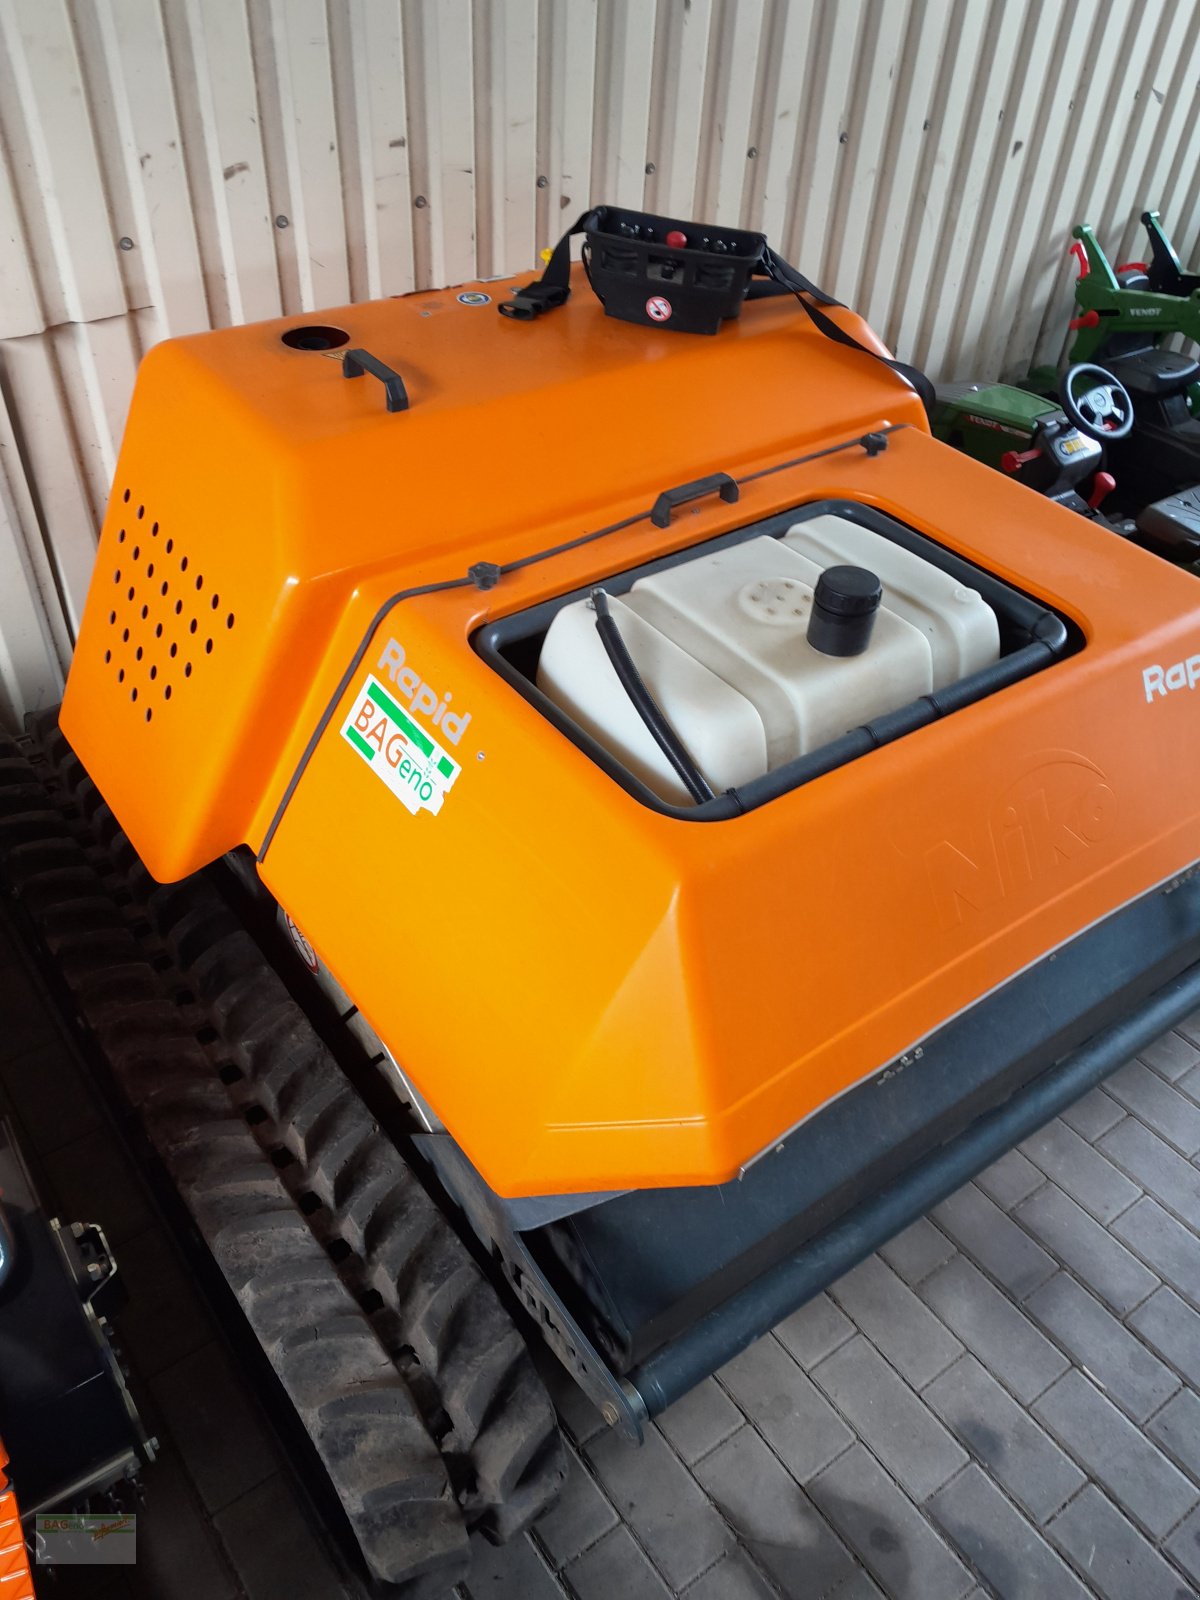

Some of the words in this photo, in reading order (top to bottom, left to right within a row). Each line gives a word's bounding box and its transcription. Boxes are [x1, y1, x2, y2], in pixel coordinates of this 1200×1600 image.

[1129, 307, 1163, 317] FENDT
[378, 638, 472, 745] Rapid
[355, 700, 433, 801] BAGeno
